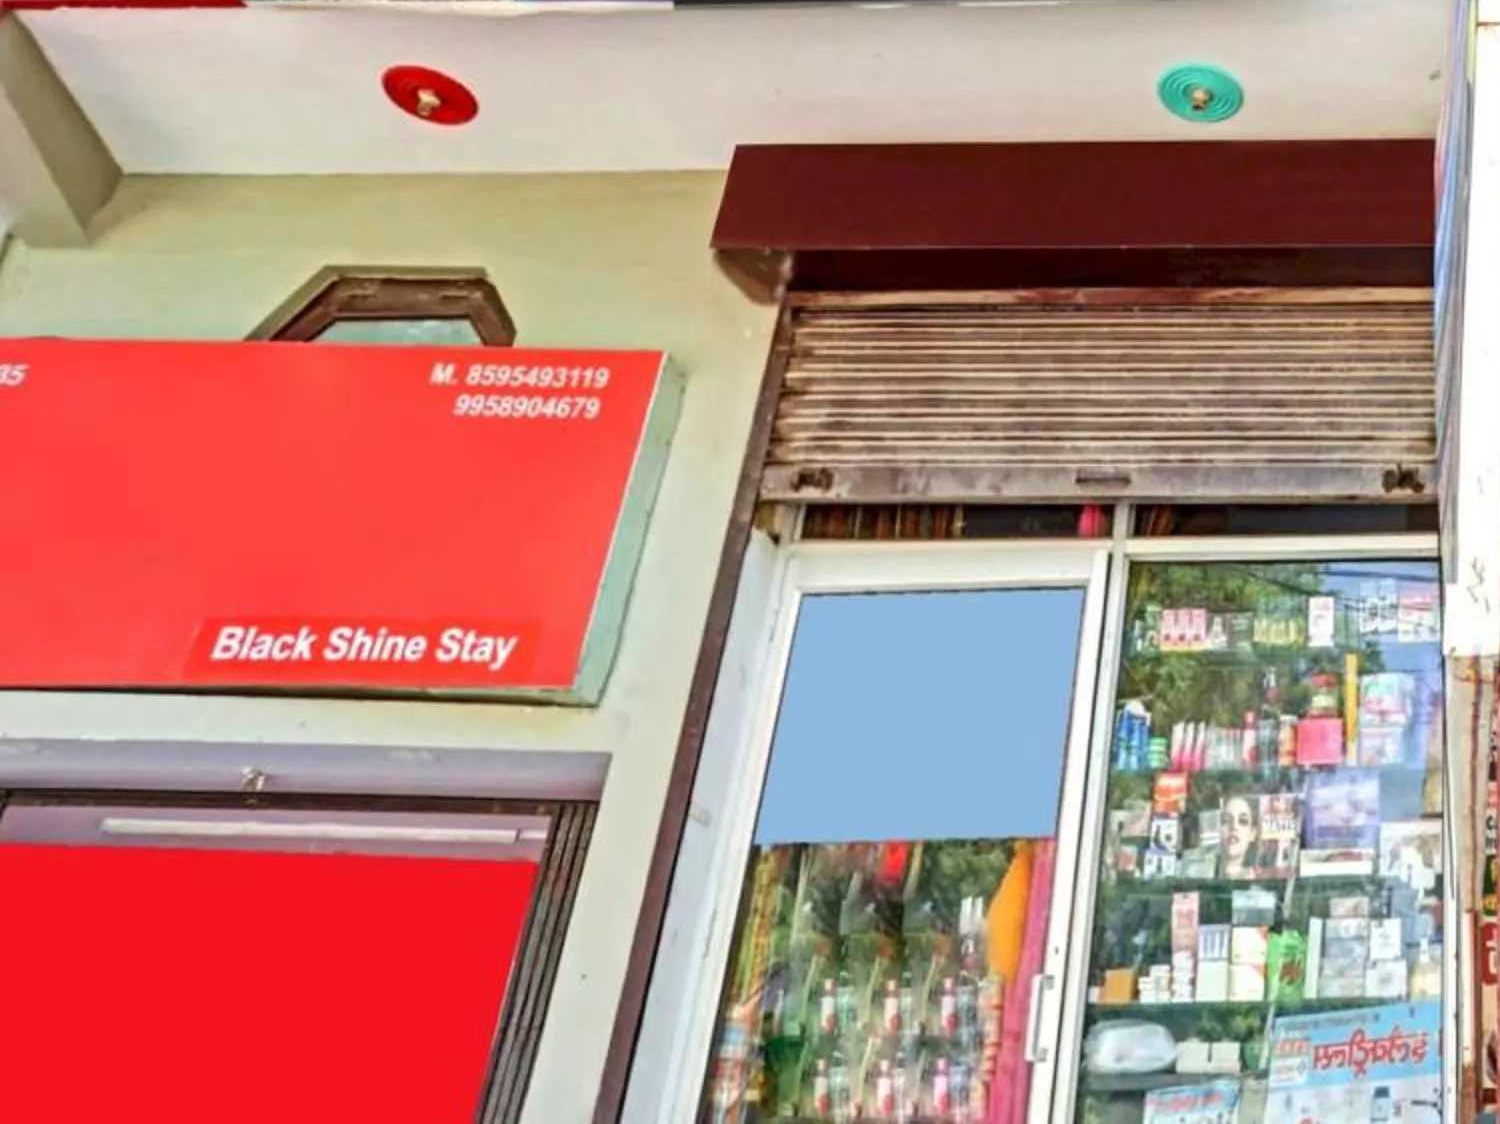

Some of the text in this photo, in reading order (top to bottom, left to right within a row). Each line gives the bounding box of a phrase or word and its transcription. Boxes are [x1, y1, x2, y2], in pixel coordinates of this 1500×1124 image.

[430, 362, 610, 389] M. 8595493119
[453, 393, 601, 420] 9958904679
[210, 626, 518, 671] Black Shine Stay
